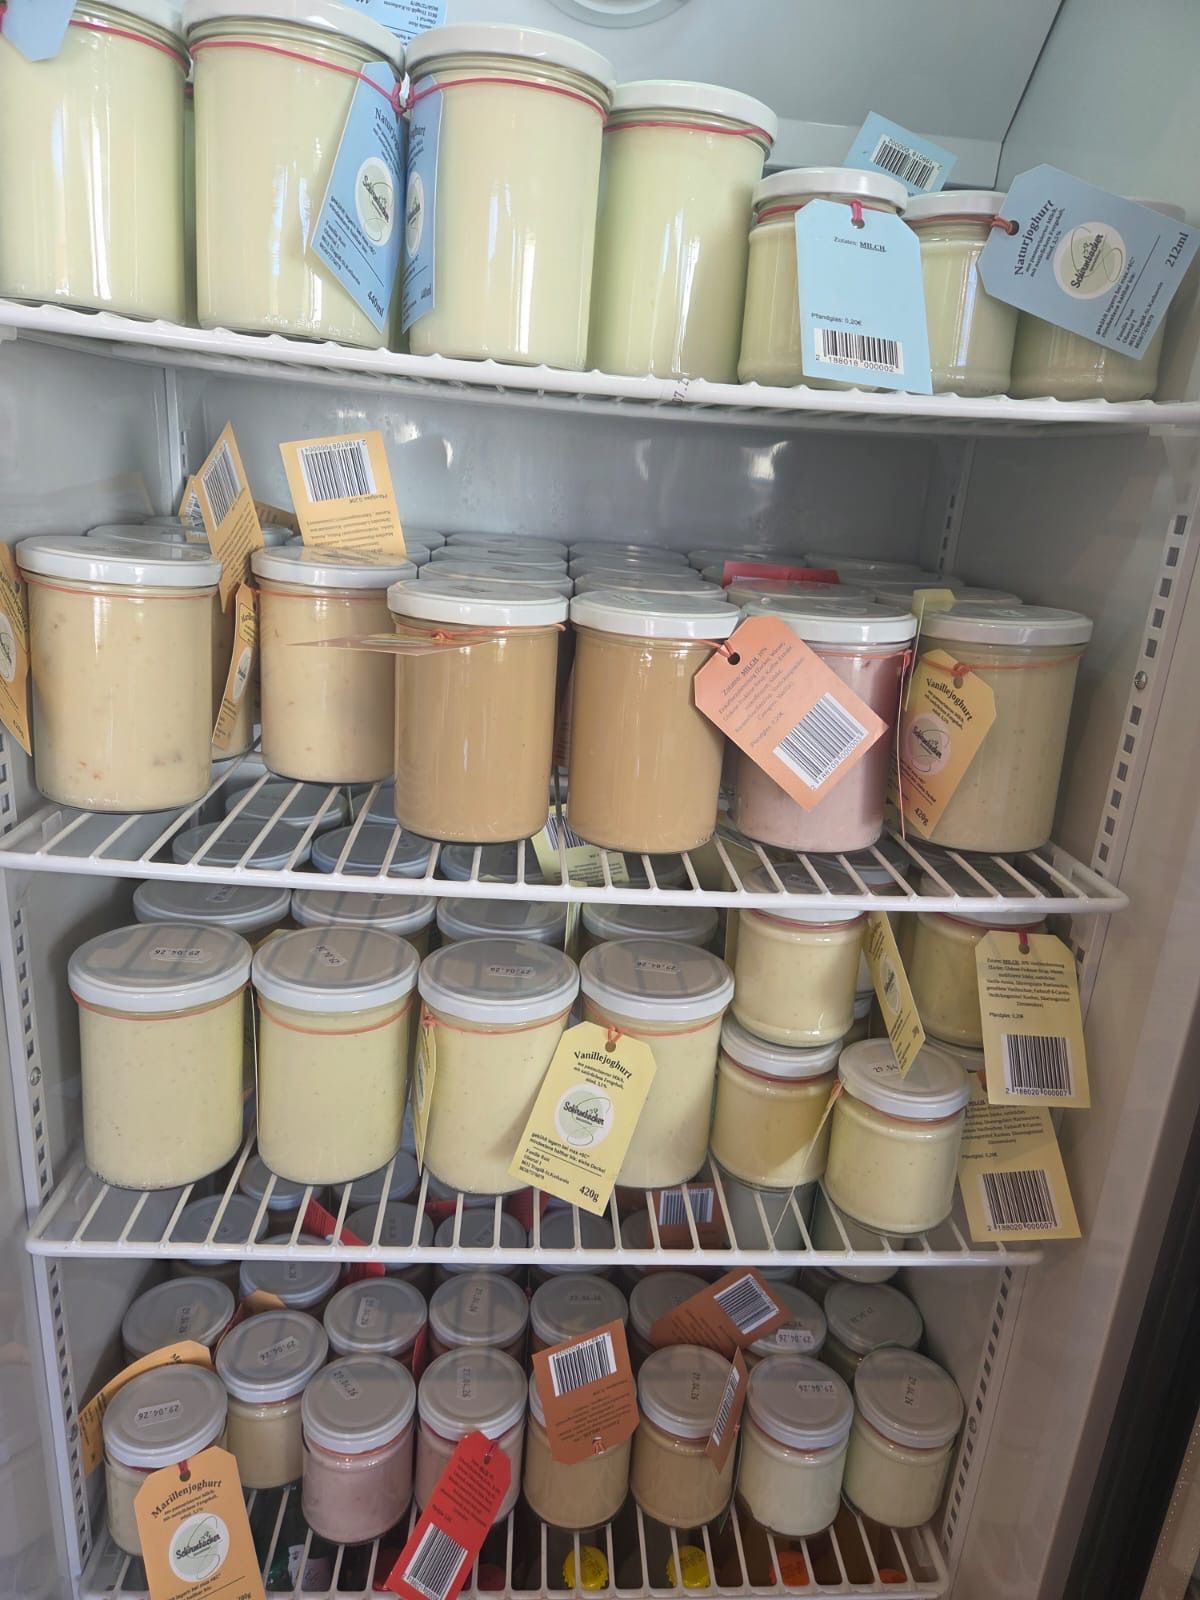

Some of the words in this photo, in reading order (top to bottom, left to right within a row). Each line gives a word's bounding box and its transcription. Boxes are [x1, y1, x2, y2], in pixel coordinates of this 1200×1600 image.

[1014, 199, 1054, 276] Naturjoghurt
[1164, 231, 1189, 267] 212ml
[863, 361, 895, 372] 000002
[926, 677, 973, 722] Vanillejoghurt
[574, 1051, 632, 1079] Vanillejoghurt
[578, 1184, 600, 1203] 420g
[138, 1404, 179, 1420] 29.04.26
[151, 1478, 223, 1518] Marillenjoghurt
